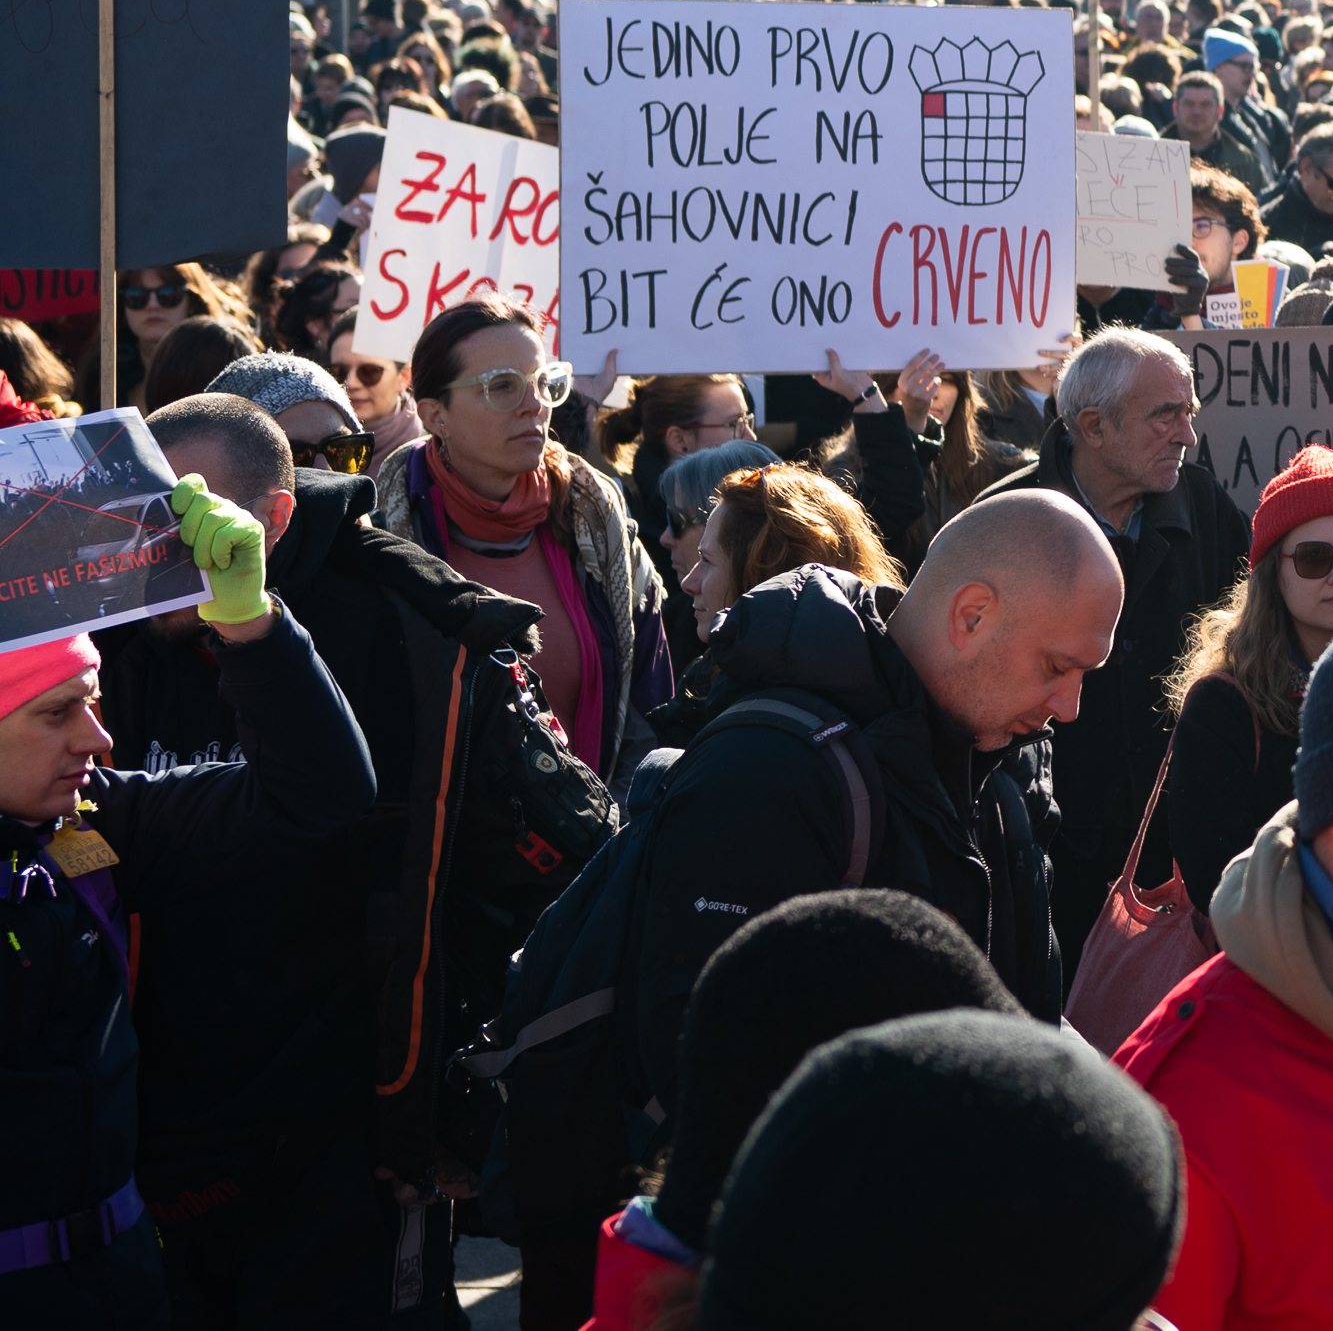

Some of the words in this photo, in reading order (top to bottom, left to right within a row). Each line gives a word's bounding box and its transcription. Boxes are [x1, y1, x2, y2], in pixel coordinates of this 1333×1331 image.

[583, 16, 741, 87] JEDINO
[767, 25, 895, 95] PRVO
[639, 100, 778, 169] POLJE
[815, 107, 884, 166] NA
[583, 170, 859, 246] ŠAHOVNICI
[872, 221, 1053, 330] CRVENO
[1104, 250, 1171, 278] PRO
[578, 268, 669, 335] BIT
[690, 262, 752, 331] ĆE
[771, 274, 853, 328] ONO
[1210, 300, 1238, 312] Ovo
[1240, 298, 1252, 311] je
[1211, 310, 1260, 325] mjesto
[42, 567, 71, 591] NE
[75, 542, 169, 583] FAŠIZMU!
[67, 848, 117, 876] 58142
